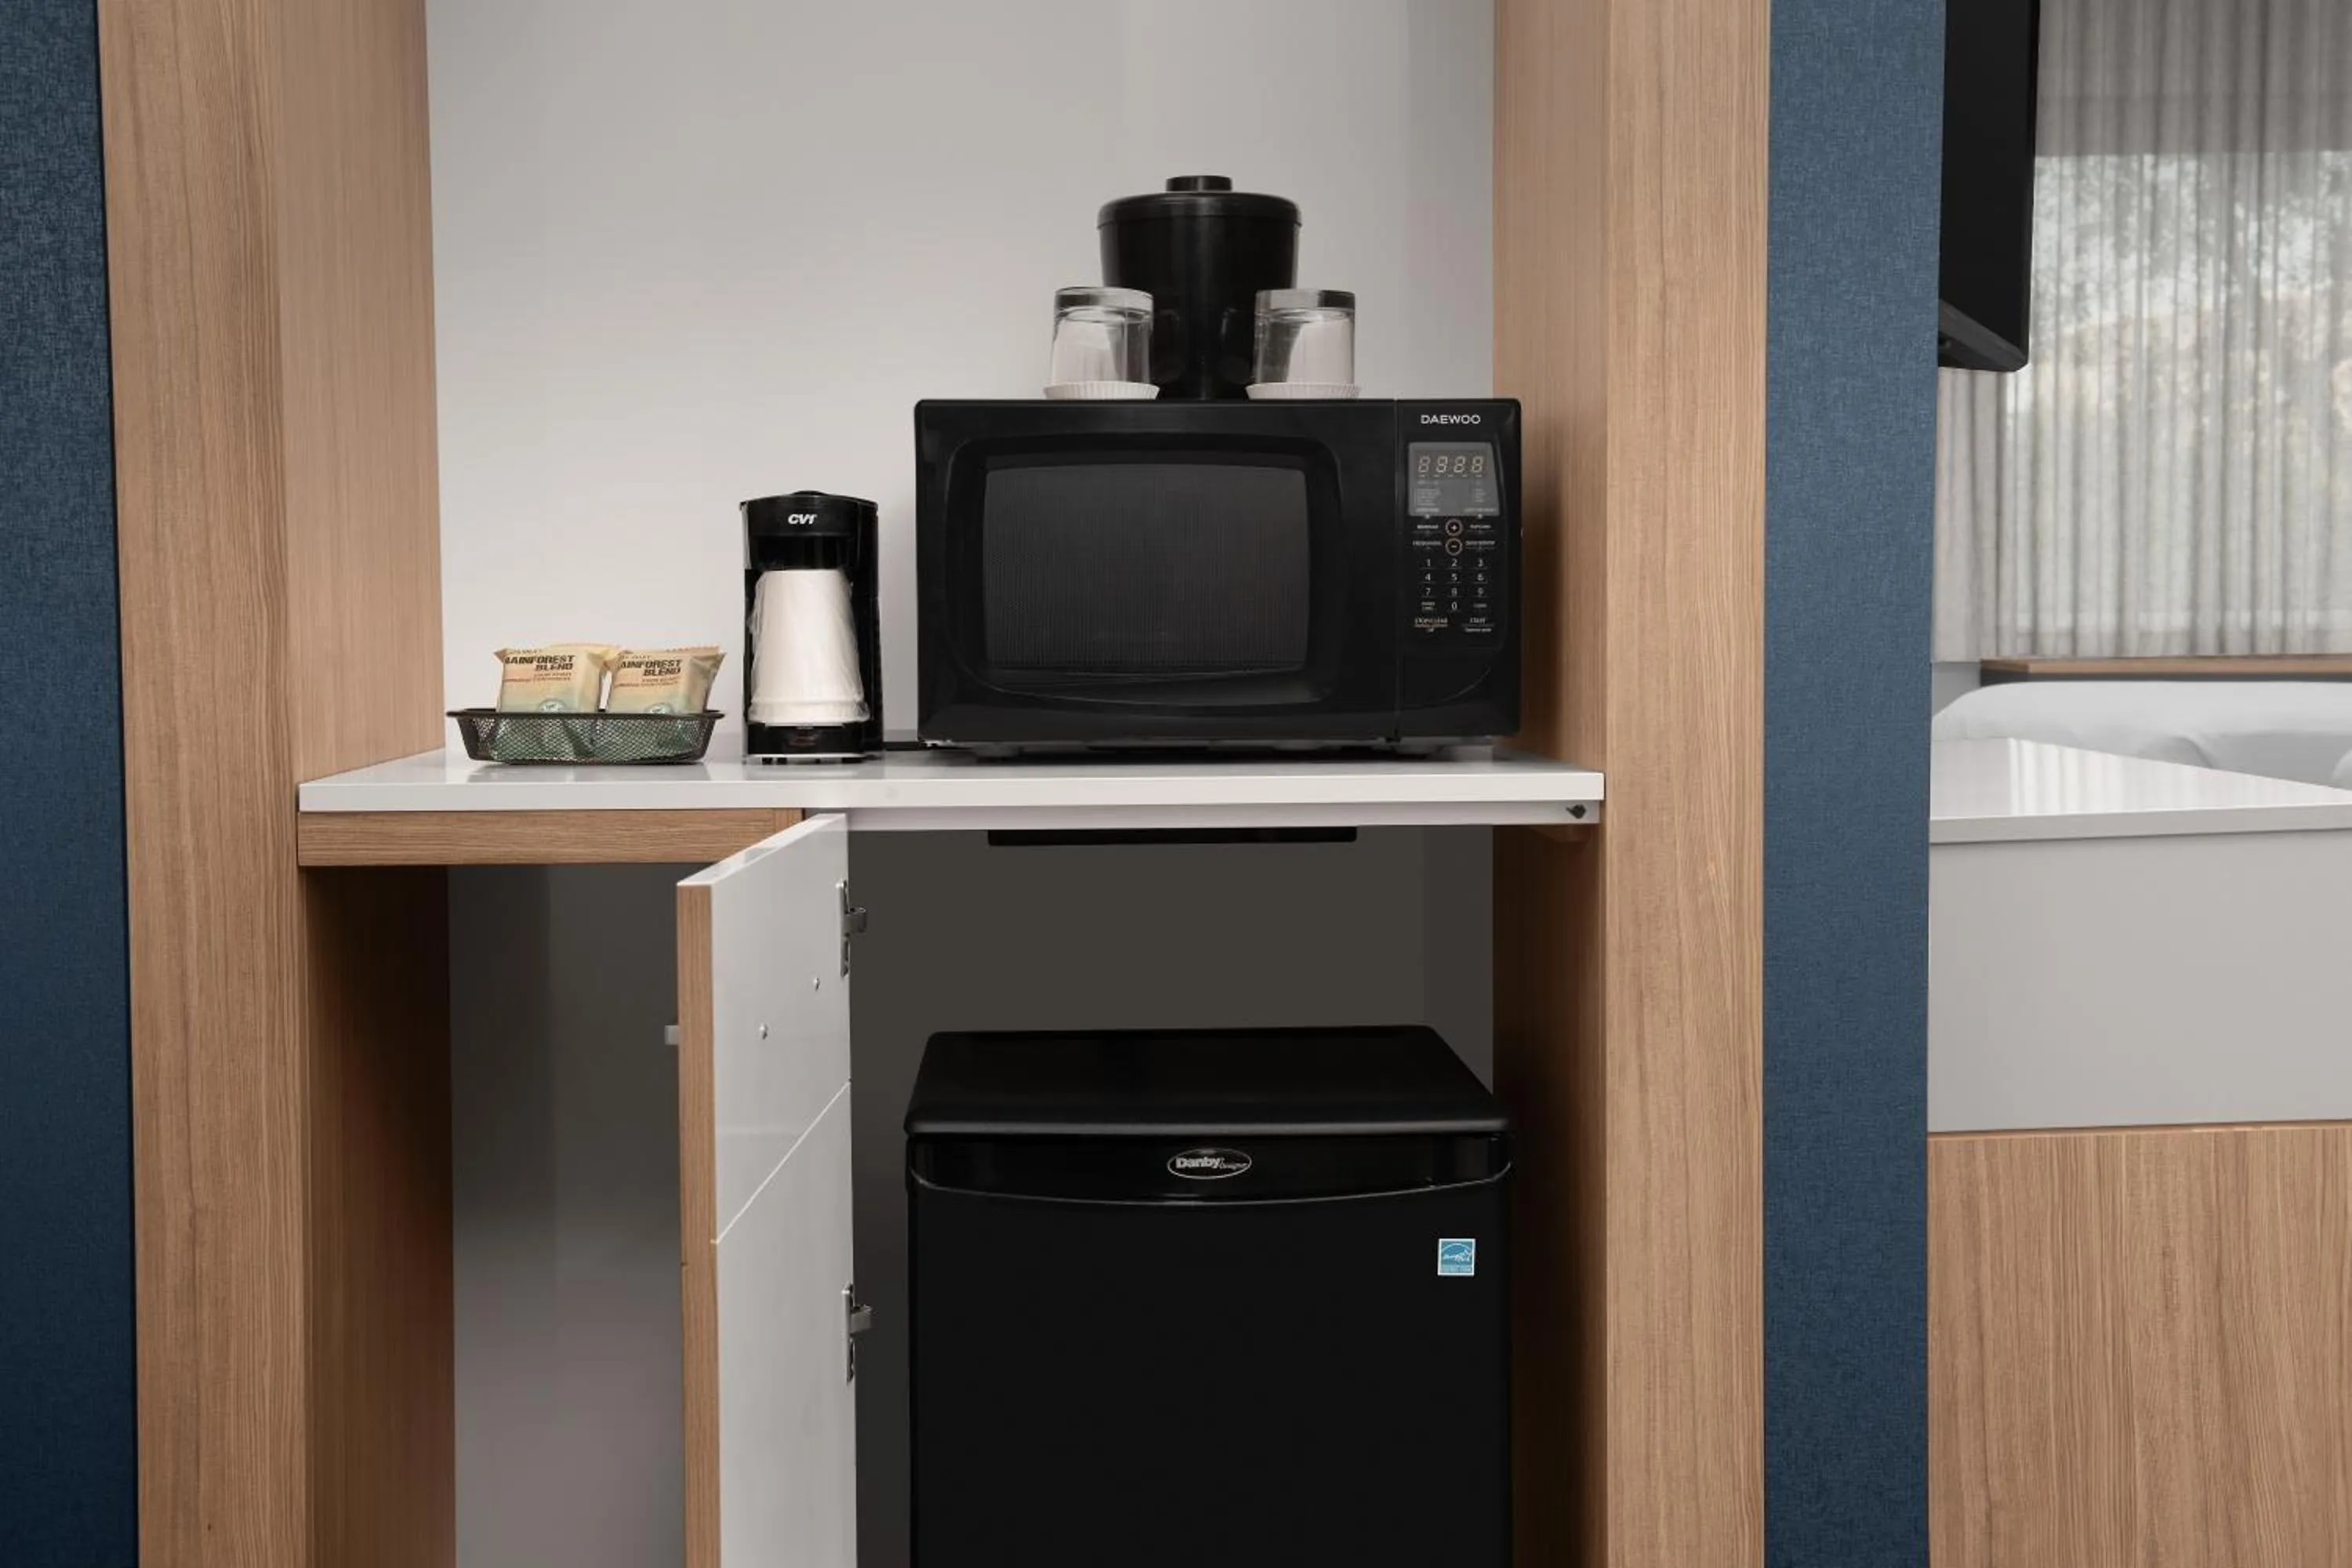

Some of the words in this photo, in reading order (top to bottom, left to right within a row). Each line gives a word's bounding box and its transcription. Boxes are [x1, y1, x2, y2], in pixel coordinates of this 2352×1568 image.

[1421, 415, 1481, 424] DAEWOO
[1451, 558, 1457, 567] 2
[1451, 601, 1457, 611] 0
[1176, 1156, 1221, 1169] Danby
